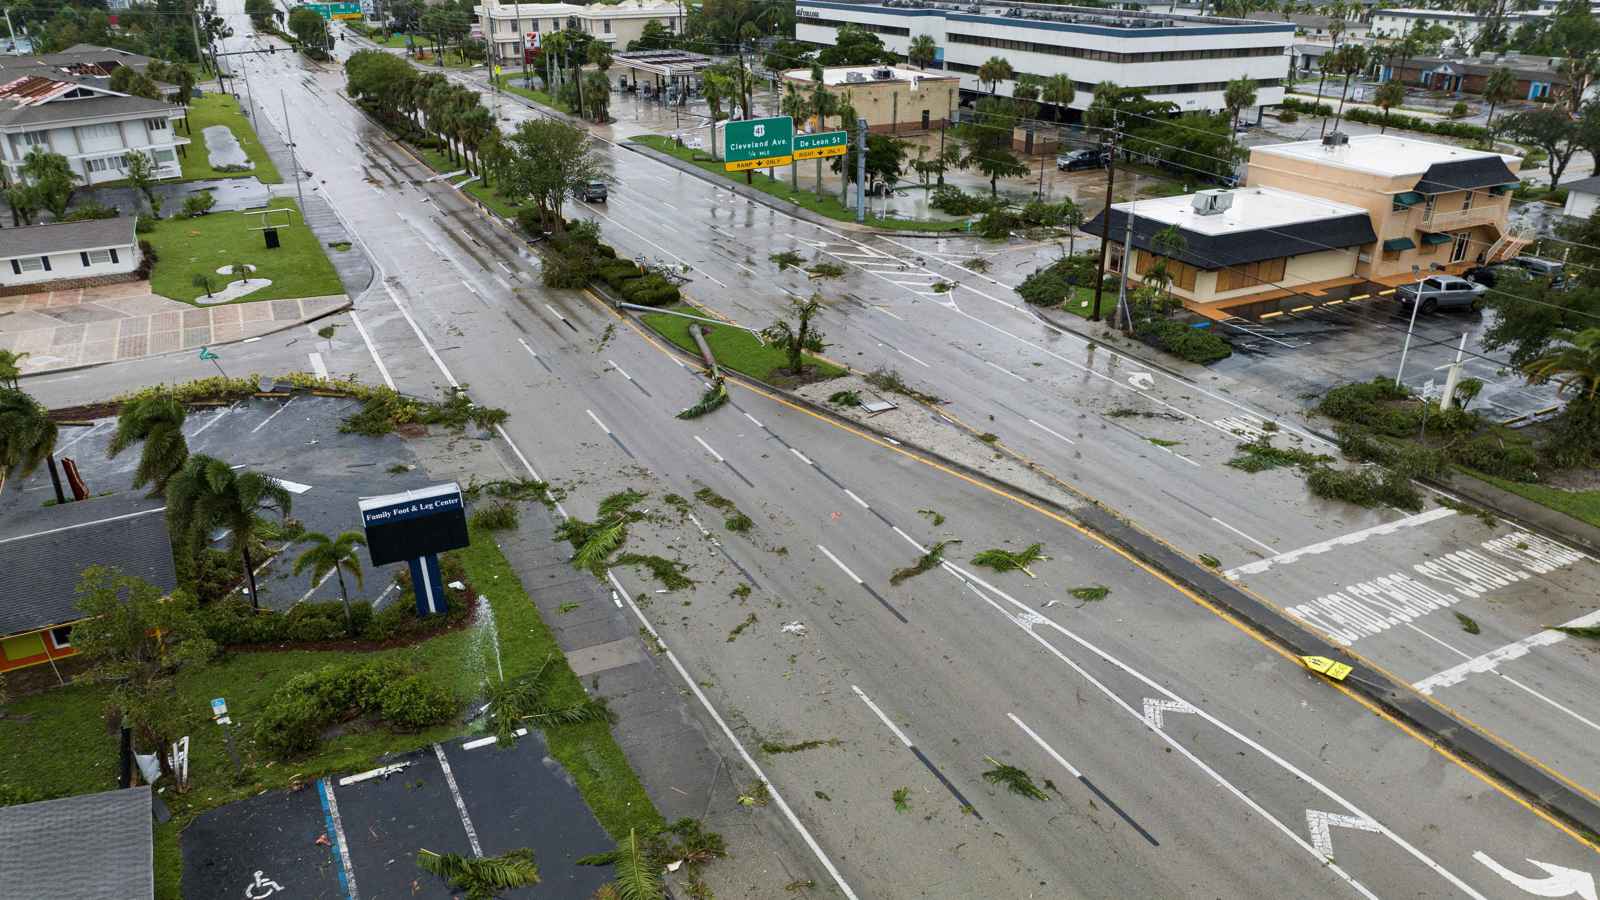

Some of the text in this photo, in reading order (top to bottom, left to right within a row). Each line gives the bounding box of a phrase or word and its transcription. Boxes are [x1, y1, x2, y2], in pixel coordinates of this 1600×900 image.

[730, 140, 769, 151] Cleveland
[812, 138, 829, 146] Leon
[832, 136, 840, 144] St
[366, 511, 392, 520] Family
[393, 507, 409, 516] Foot
[434, 498, 458, 507] Center
[1284, 591, 1398, 646] SCHOOL
[1345, 573, 1460, 622] SCHOOL
[1413, 549, 1532, 598] SCHOOL
